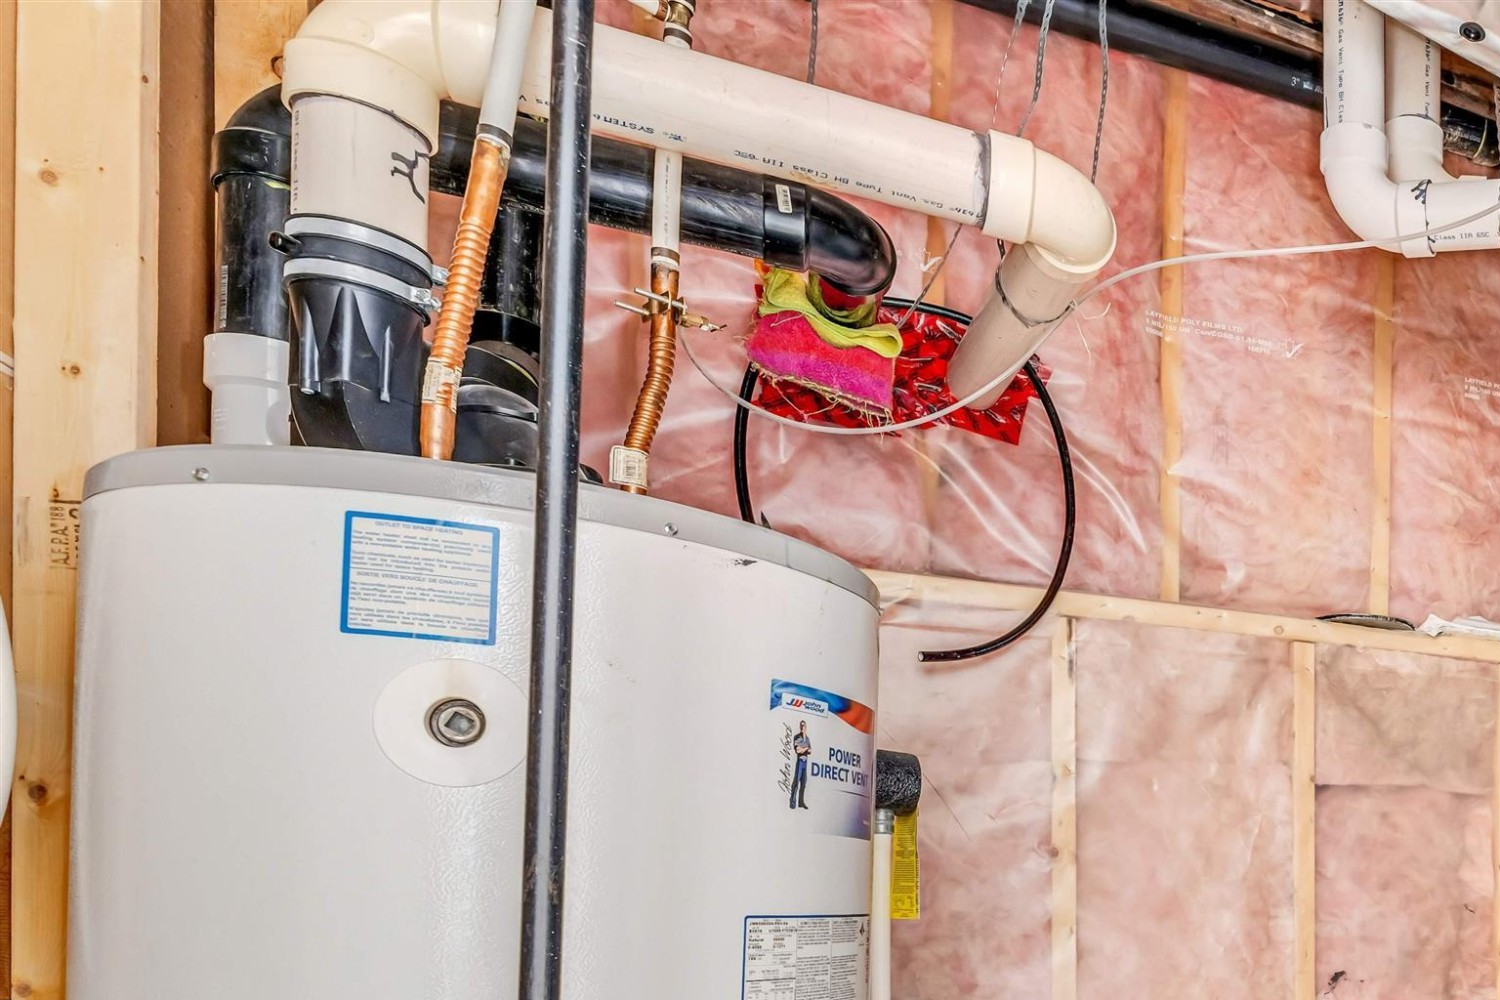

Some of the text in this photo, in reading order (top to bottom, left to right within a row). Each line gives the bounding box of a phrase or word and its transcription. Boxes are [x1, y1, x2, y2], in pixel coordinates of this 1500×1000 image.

[828, 747, 862, 769] POWER
[810, 761, 869, 788] DIRECT VENT
